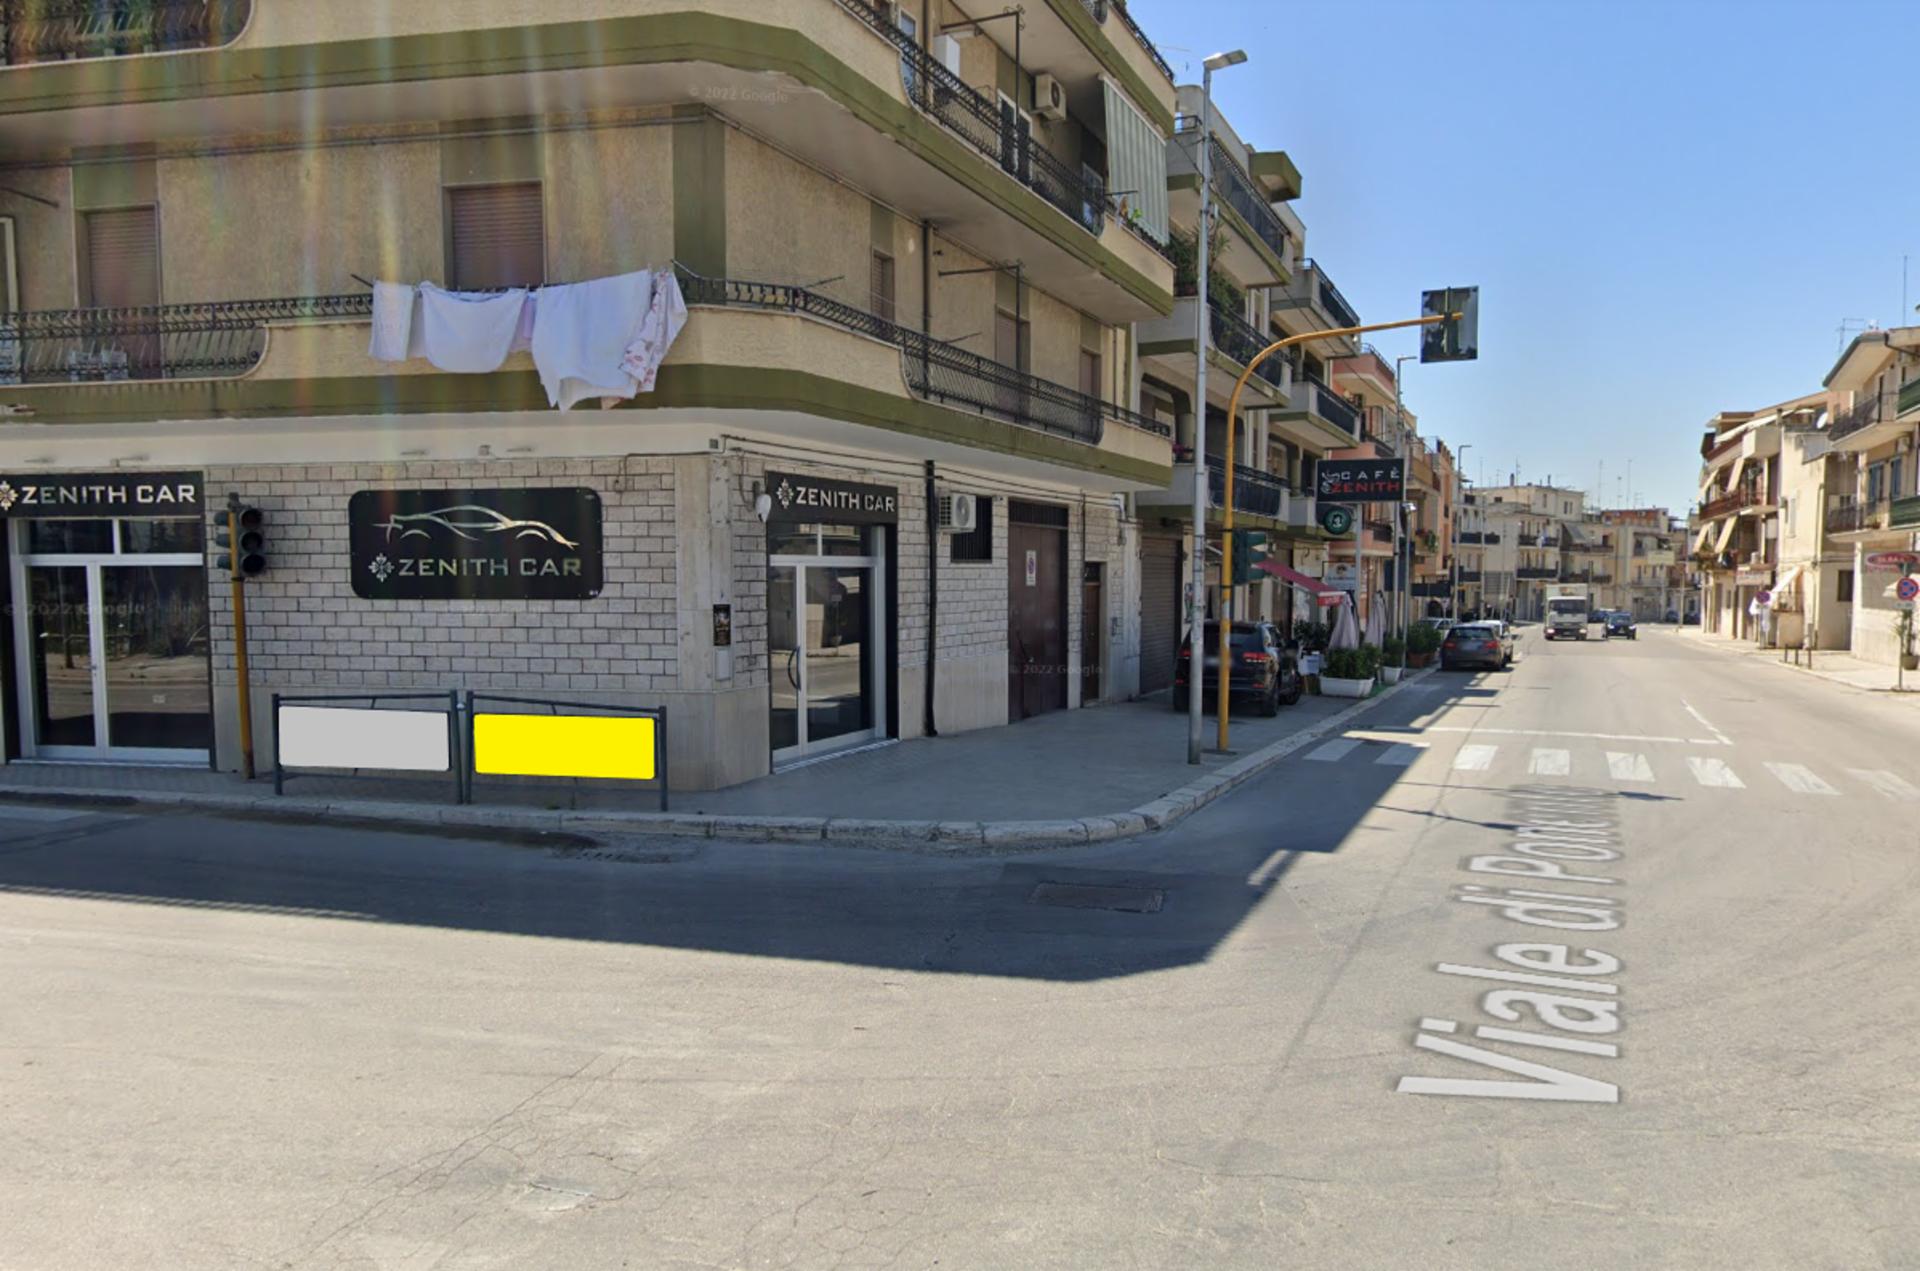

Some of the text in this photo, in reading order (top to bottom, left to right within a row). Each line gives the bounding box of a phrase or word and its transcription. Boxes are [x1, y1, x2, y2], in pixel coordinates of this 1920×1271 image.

[21, 484, 196, 504] ZENITH CAR
[1331, 481, 1400, 493] ZENITH
[796, 486, 895, 513] ZENITH CAR
[399, 557, 582, 577] ZENITH CAR
